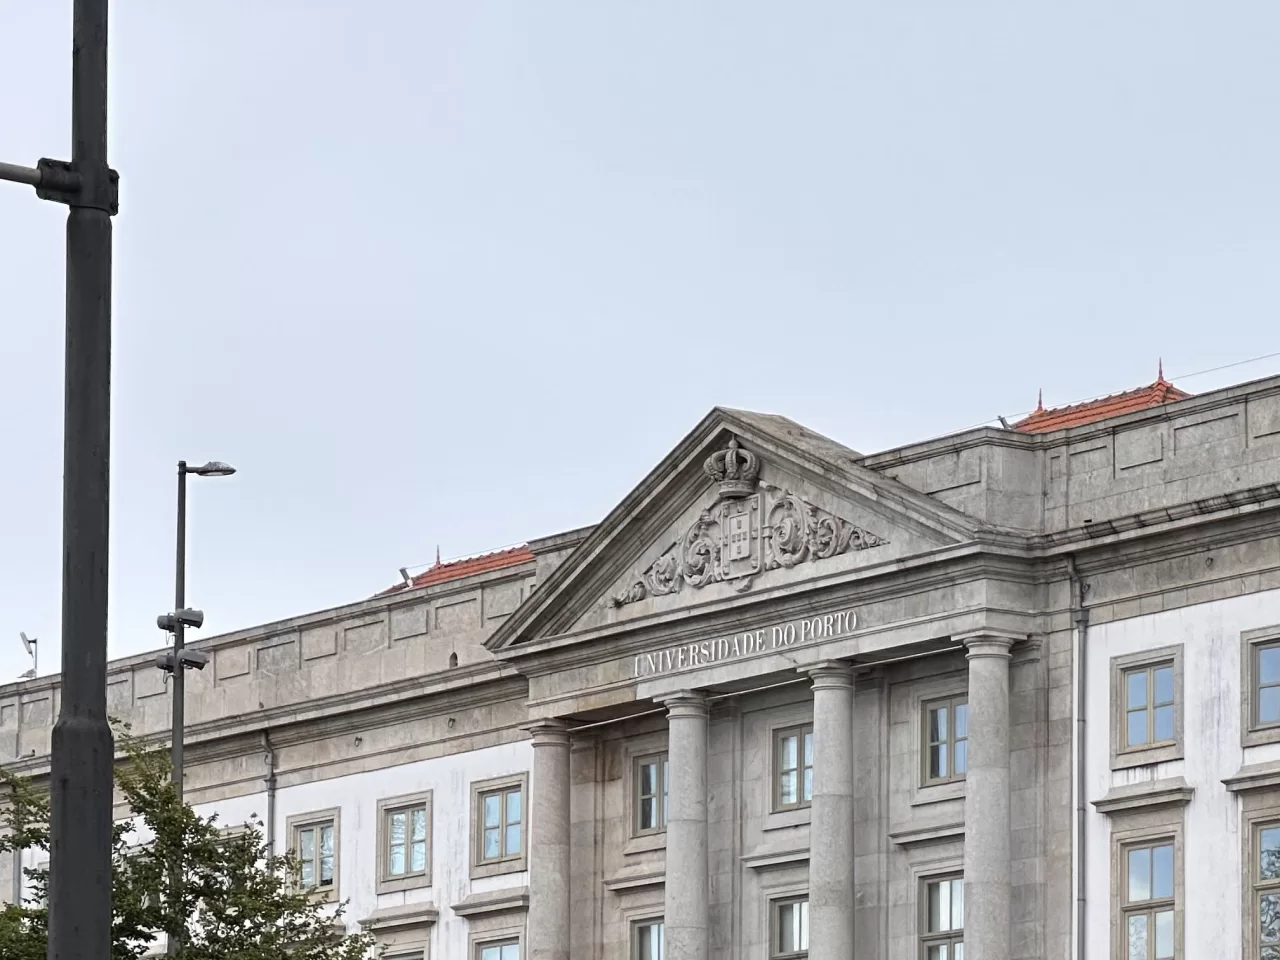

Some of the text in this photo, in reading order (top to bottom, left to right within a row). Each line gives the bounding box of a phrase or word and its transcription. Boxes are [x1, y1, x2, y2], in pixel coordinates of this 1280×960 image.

[633, 609, 857, 677] UNIVERSIDADE DO PORTO
